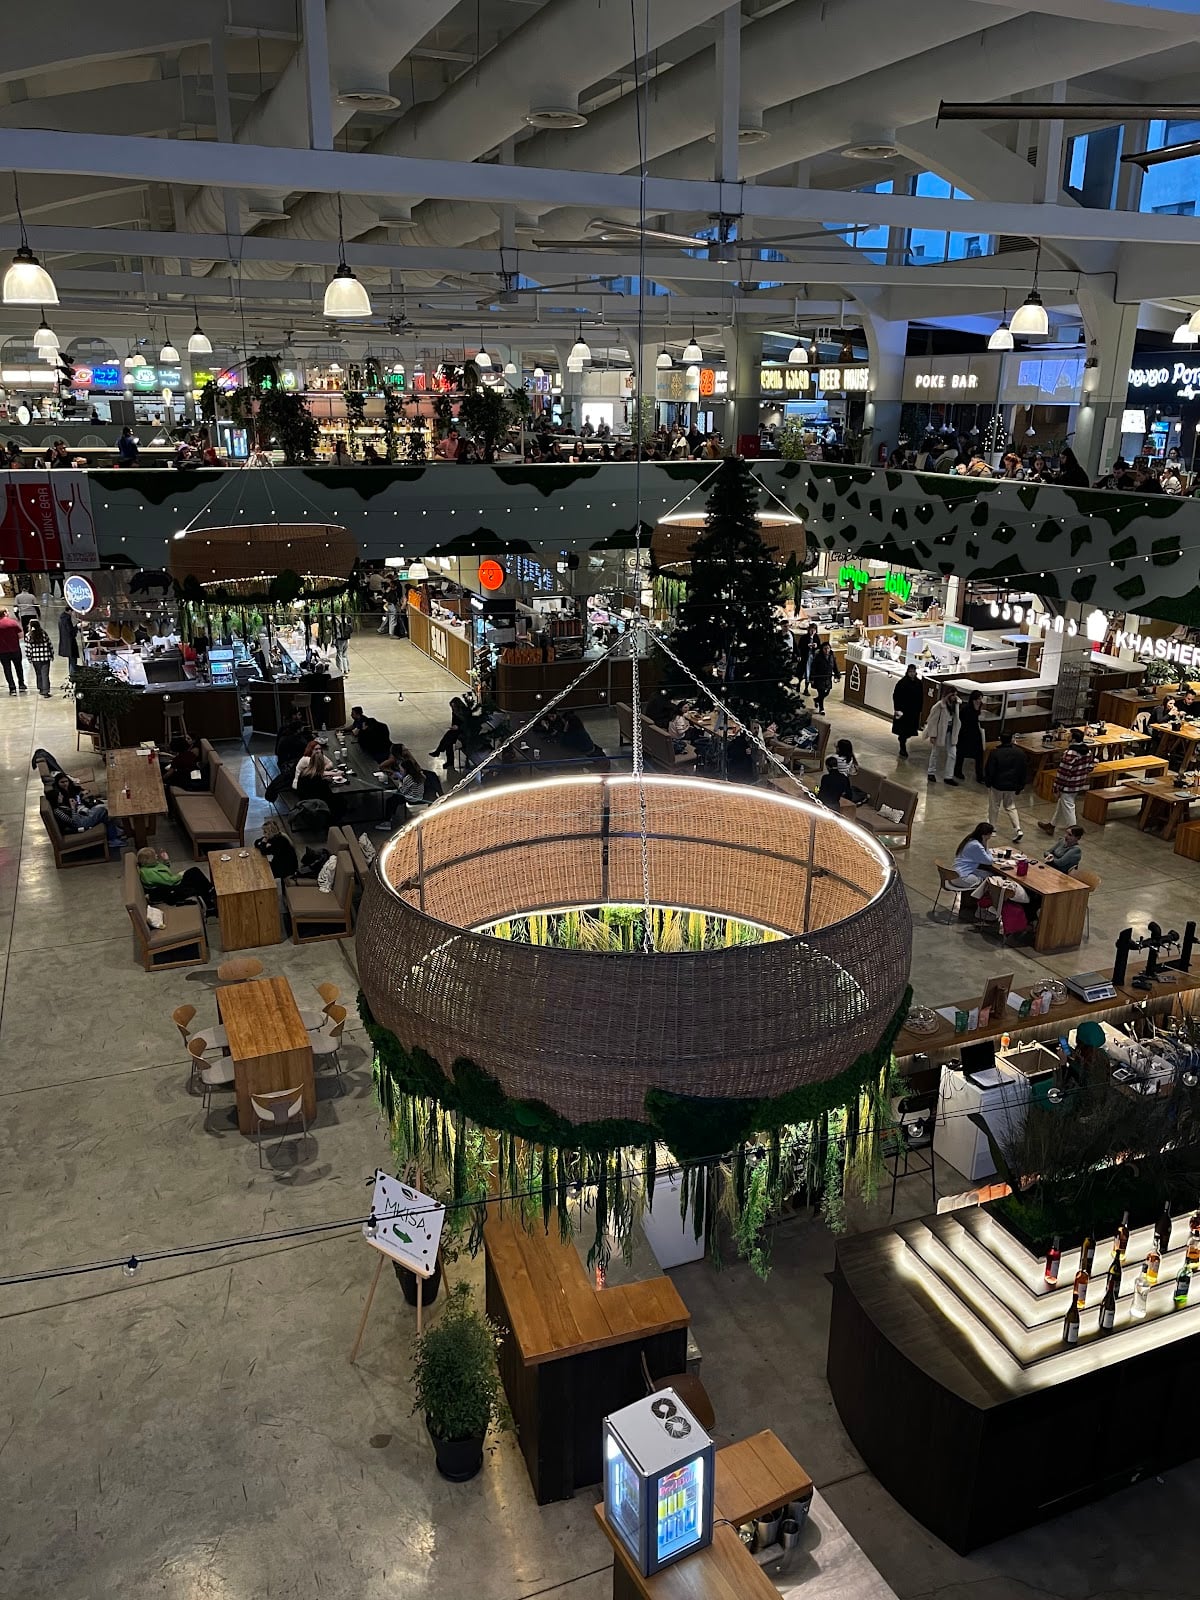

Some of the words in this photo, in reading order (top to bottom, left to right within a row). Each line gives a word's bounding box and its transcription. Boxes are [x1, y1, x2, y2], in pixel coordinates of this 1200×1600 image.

[819, 369, 841, 390] BEER
[843, 368, 869, 390] HOUSE
[915, 374, 946, 388] POKE
[951, 374, 978, 388] BAR
[37, 487, 50, 509] BAR
[43, 511, 55, 540] WINE
